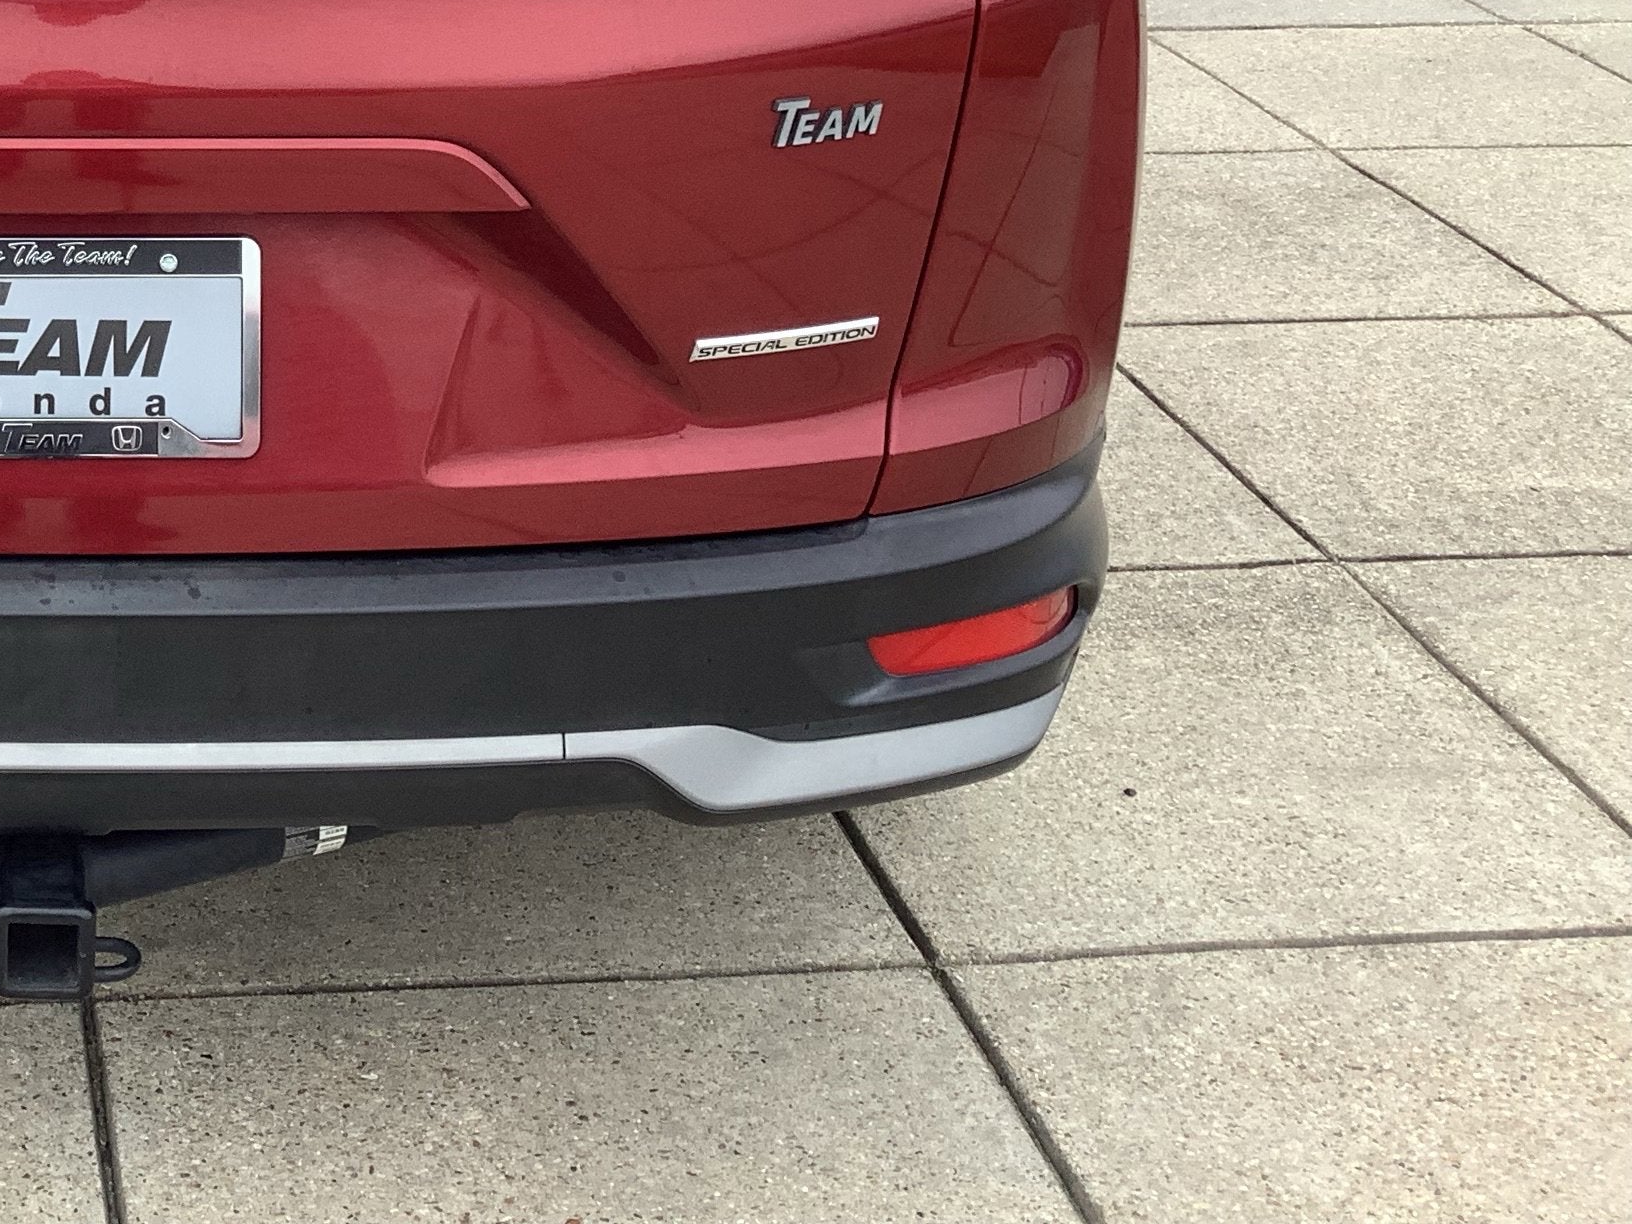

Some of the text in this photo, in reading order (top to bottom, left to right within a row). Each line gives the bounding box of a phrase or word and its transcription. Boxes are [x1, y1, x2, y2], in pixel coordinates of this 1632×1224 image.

[773, 97, 884, 148] TEAM
[8, 241, 55, 266] The
[57, 241, 138, 266] Team!
[697, 325, 876, 358] SPECIAL EDITION
[1, 422, 84, 452] TEAM
